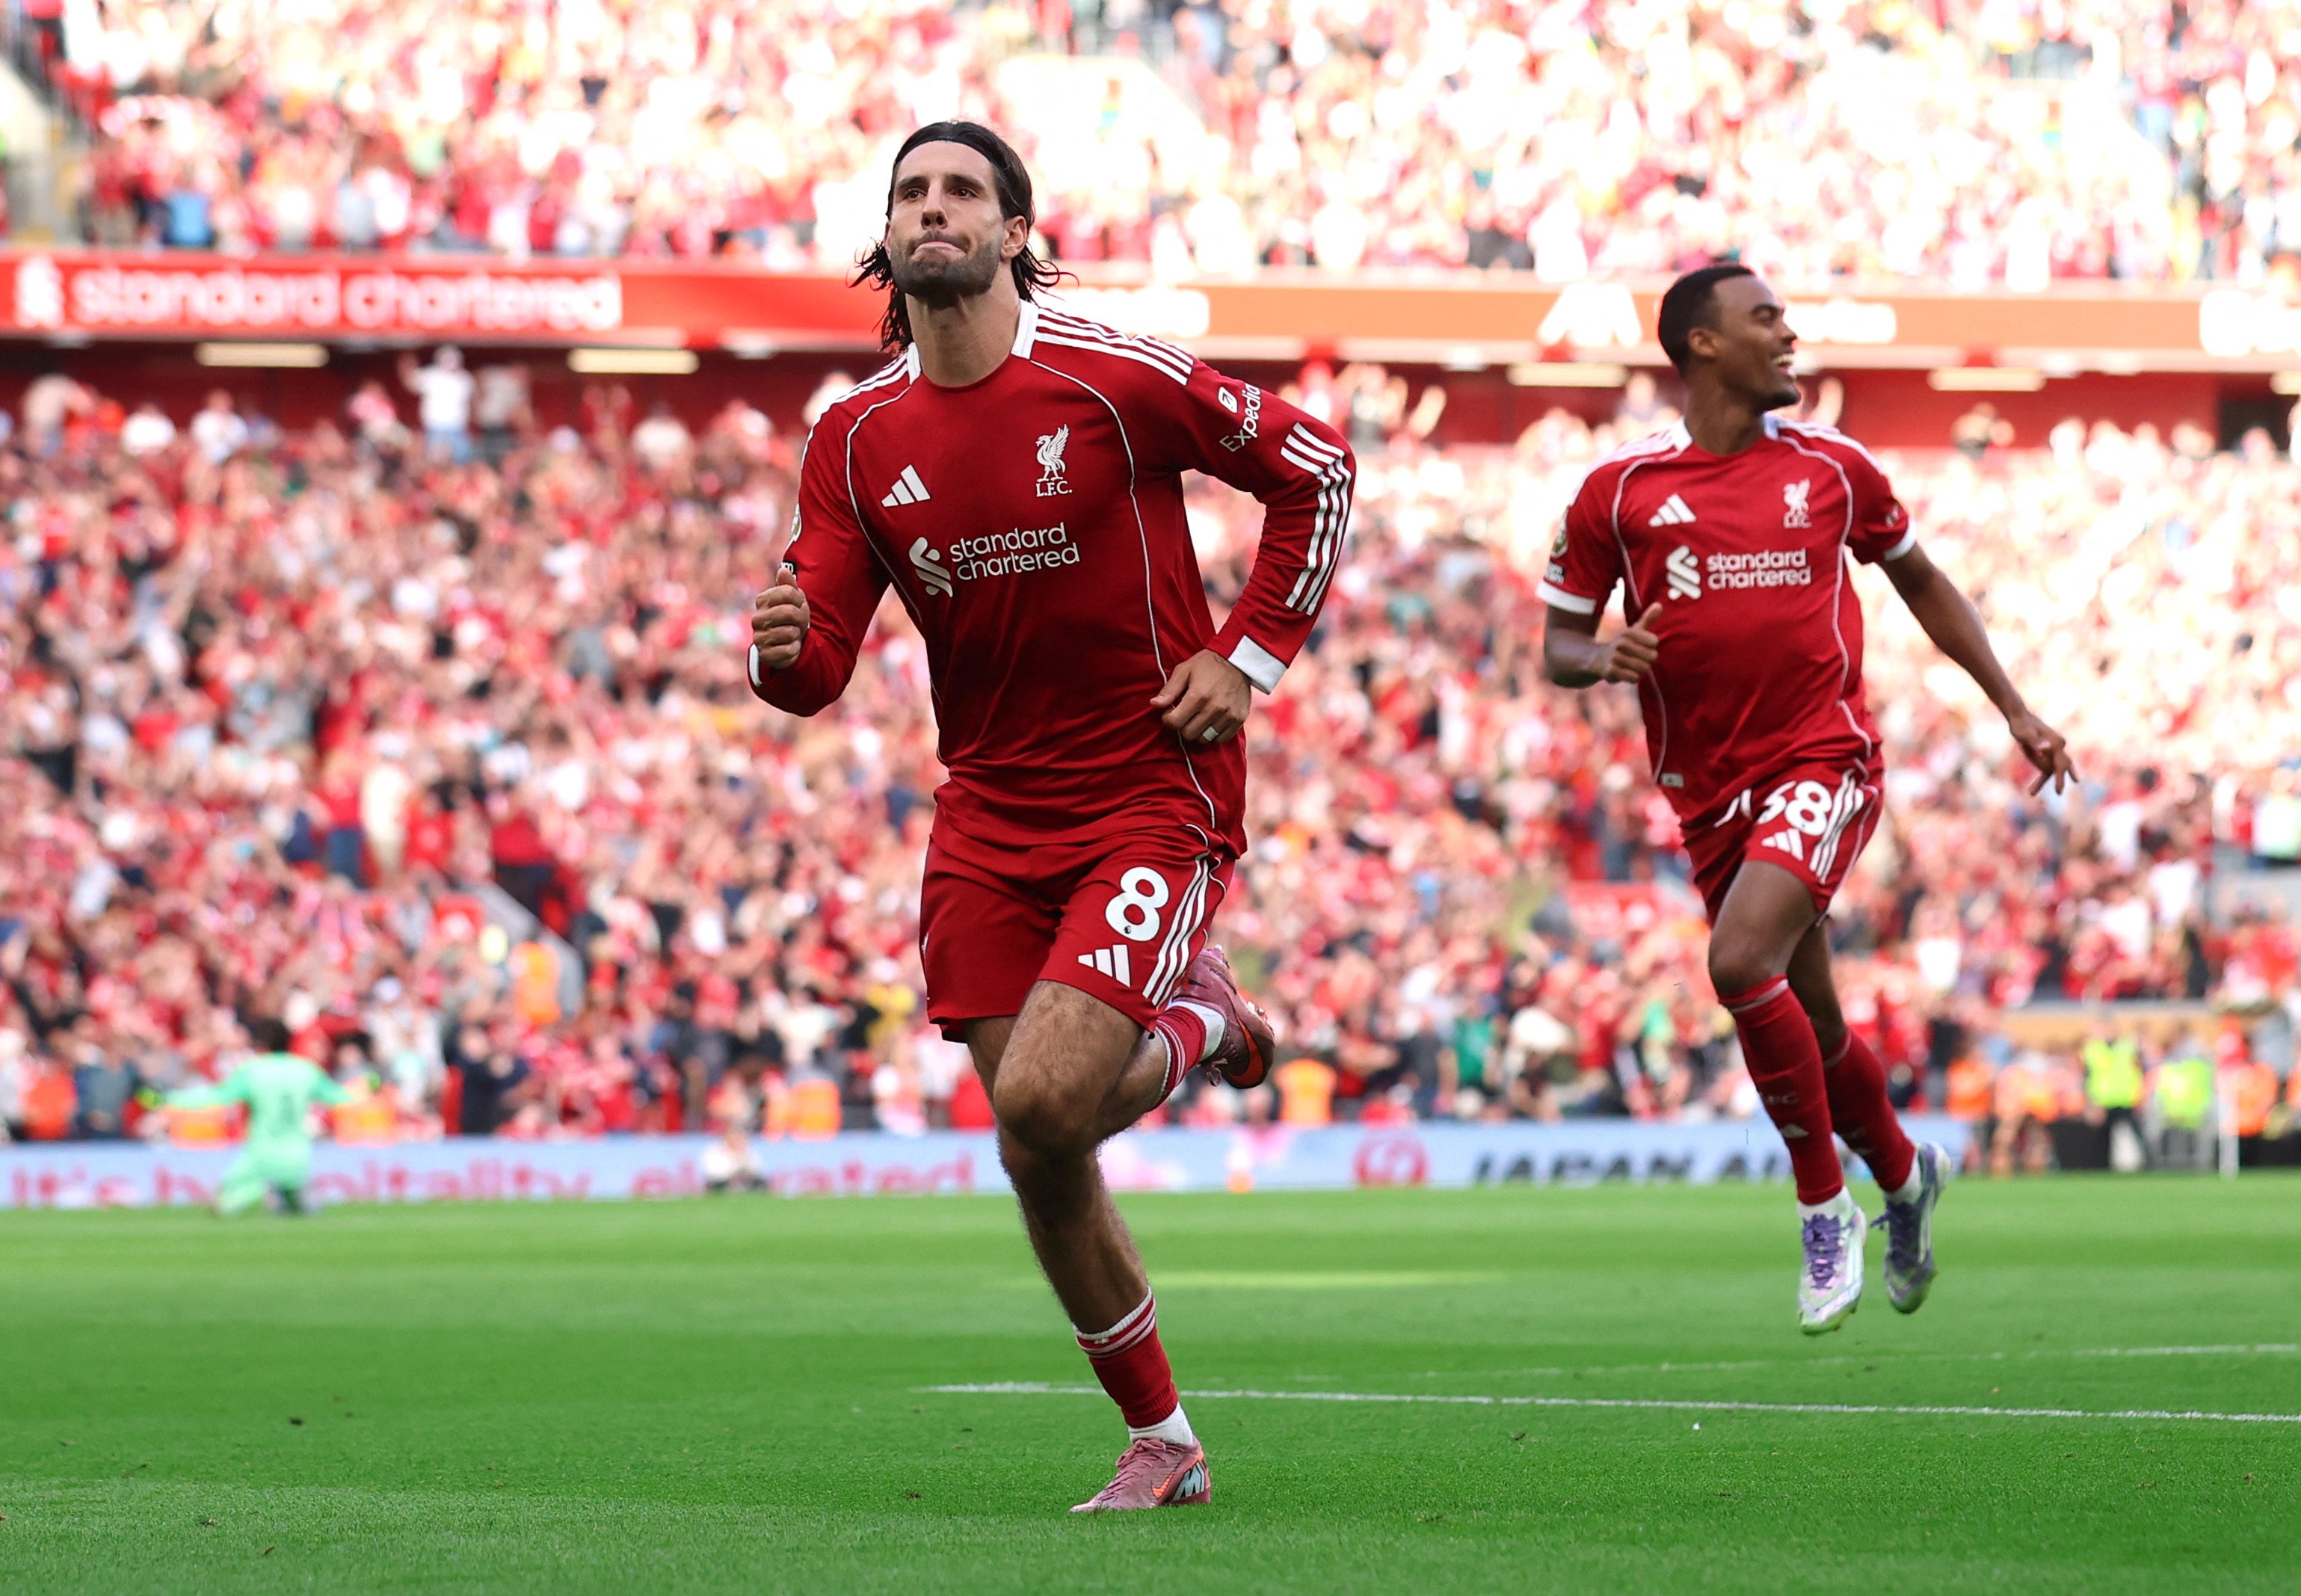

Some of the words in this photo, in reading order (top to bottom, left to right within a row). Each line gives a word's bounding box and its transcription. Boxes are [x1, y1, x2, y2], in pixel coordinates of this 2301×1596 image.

[70, 266, 342, 327] standard
[1219, 383, 1261, 452] Expedia
[949, 522, 1067, 562] standard
[957, 542, 1080, 580] chartered
[1706, 547, 1807, 573] standard
[1707, 565, 1812, 591] chartered
[1106, 866, 1169, 942] 8
